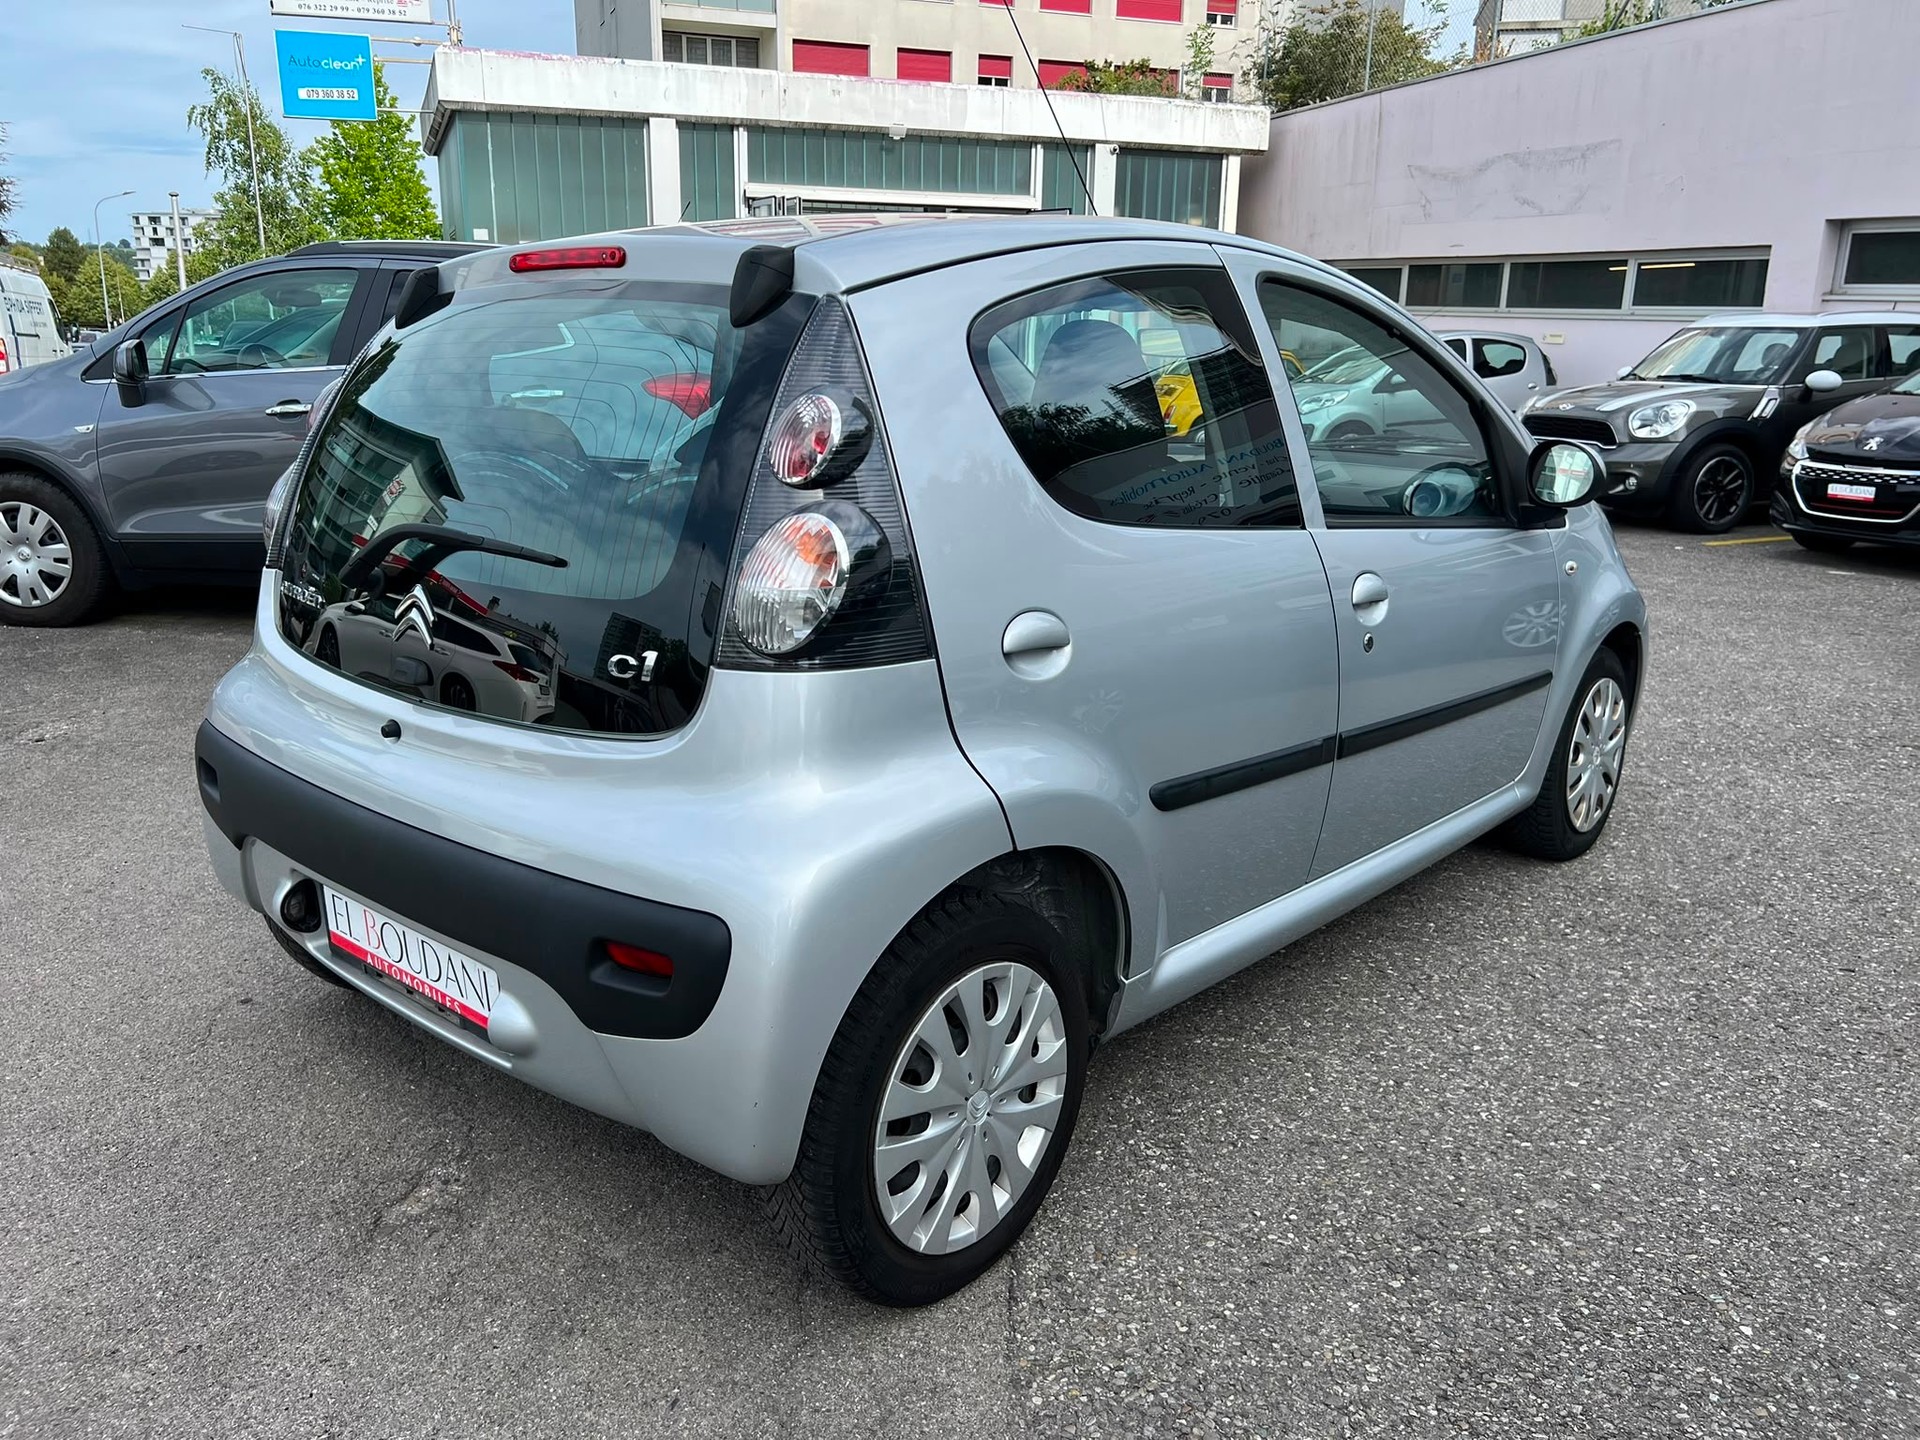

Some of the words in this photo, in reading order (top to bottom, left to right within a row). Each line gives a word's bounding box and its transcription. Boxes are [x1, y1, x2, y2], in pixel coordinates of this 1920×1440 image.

[306, 89, 319, 98] 079
[321, 89, 334, 98] 360
[336, 90, 345, 98] 38
[346, 90, 355, 99] 52
[331, 893, 360, 942] EL
[363, 908, 491, 1012] BOUDANI
[366, 952, 462, 1014] AUTOMOBILES
